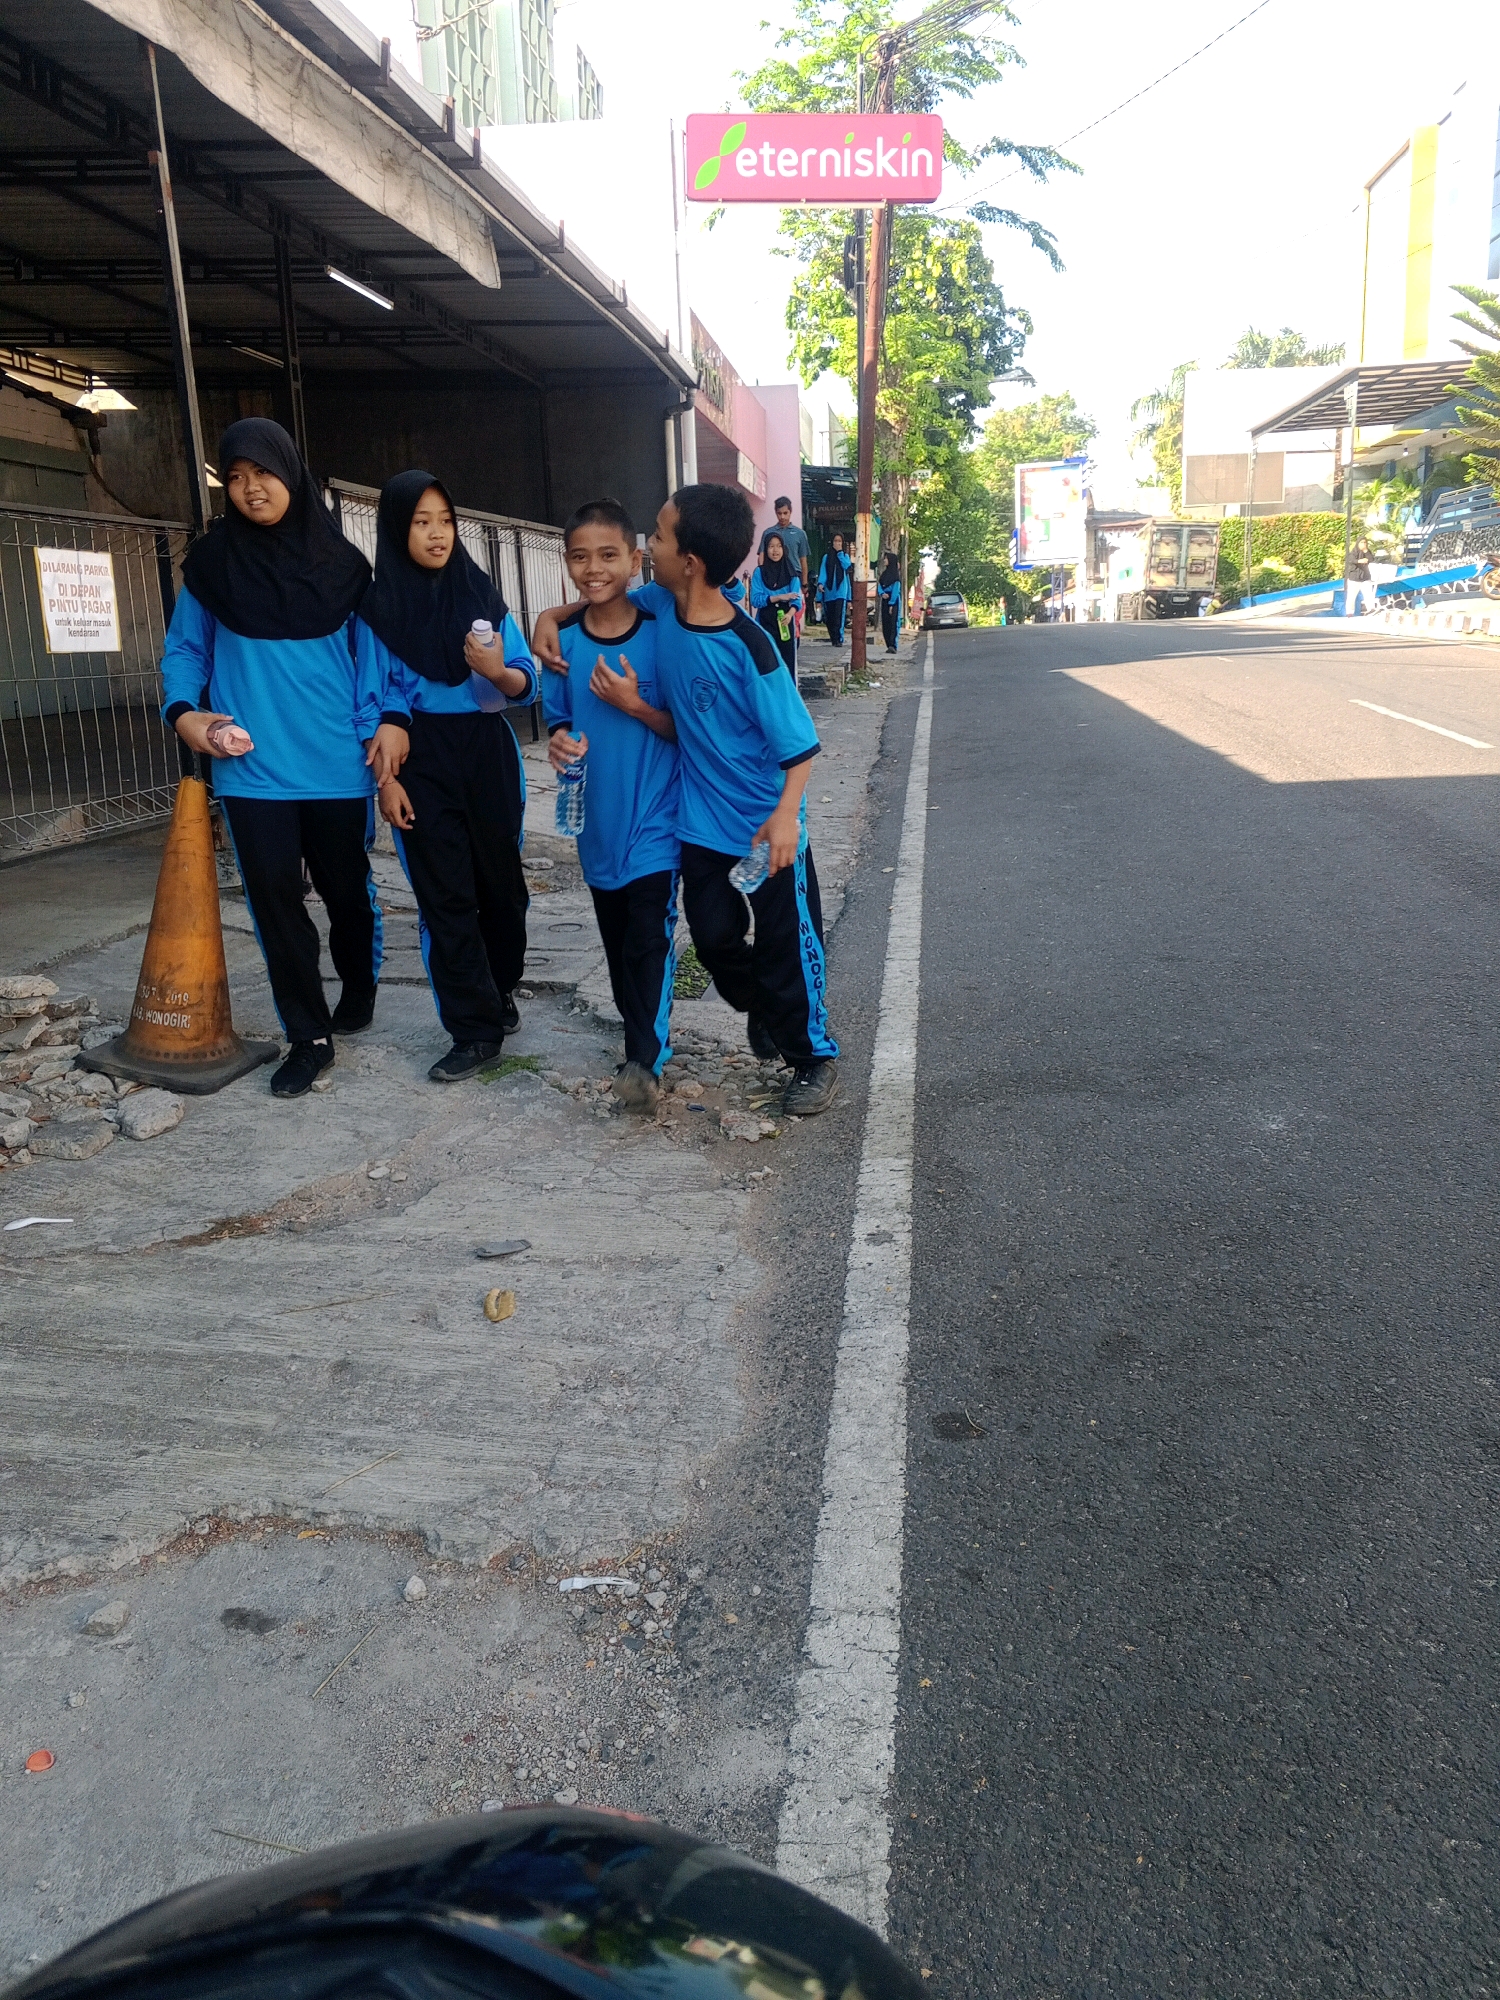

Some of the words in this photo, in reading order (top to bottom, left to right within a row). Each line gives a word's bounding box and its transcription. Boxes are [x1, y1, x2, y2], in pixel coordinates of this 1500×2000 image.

[735, 132, 933, 177] eterniskin
[42, 562, 82, 575] DILARANG
[84, 564, 110, 576] PARKIR
[58, 583, 68, 597] DI
[70, 584, 101, 598] DEPAN
[49, 599, 79, 613] PINTU
[81, 600, 112, 614] PAGAR
[55, 617, 72, 626] untuk
[73, 618, 92, 627] keluar
[93, 618, 112, 627] masuk
[68, 628, 100, 637] kendaraan
